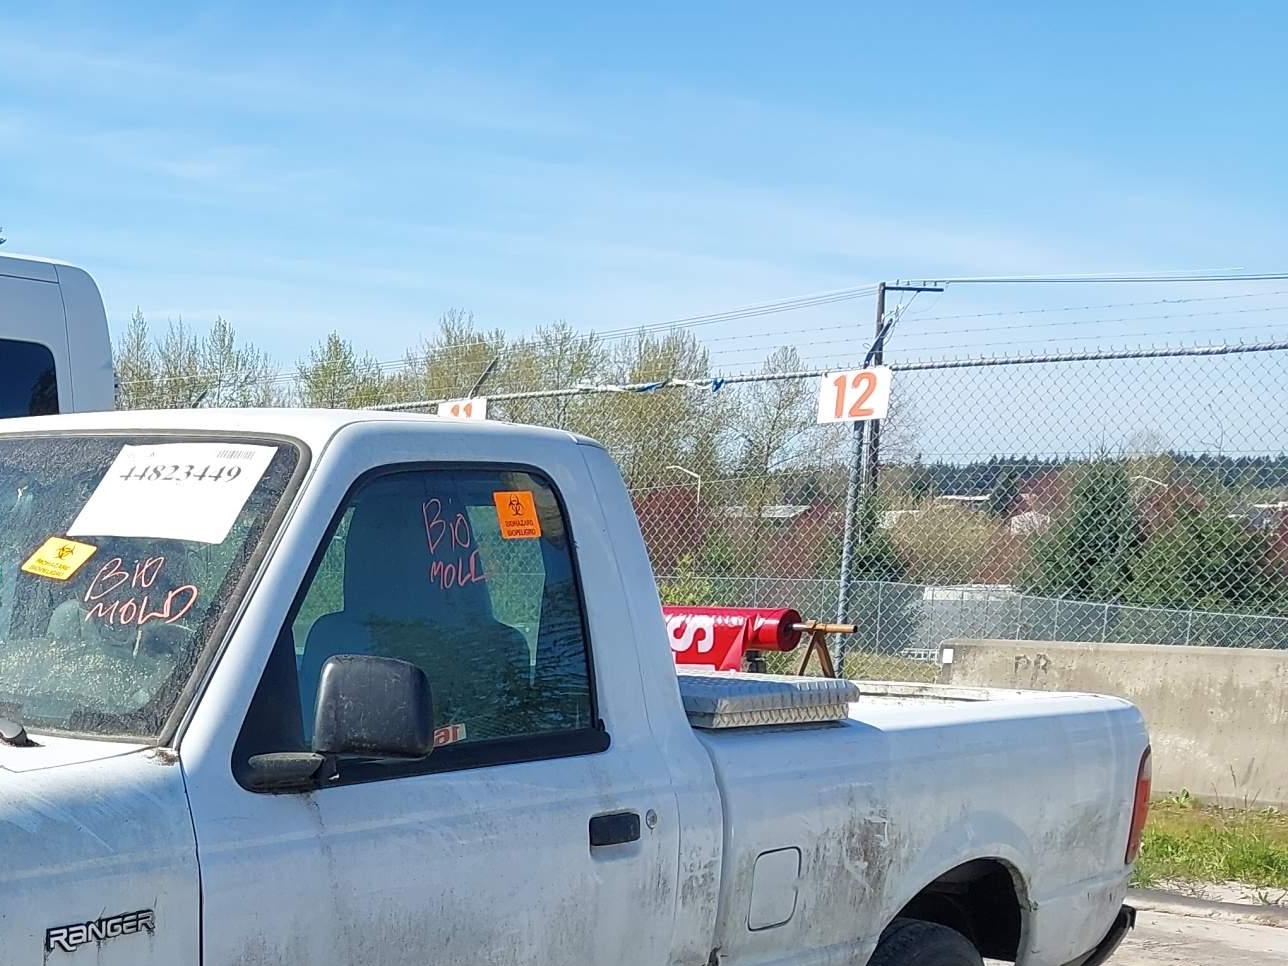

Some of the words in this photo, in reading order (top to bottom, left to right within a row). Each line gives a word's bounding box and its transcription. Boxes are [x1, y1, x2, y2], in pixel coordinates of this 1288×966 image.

[833, 371, 877, 418] 12
[120, 464, 242, 482] 44823449
[85, 585, 198, 625] MOLD
